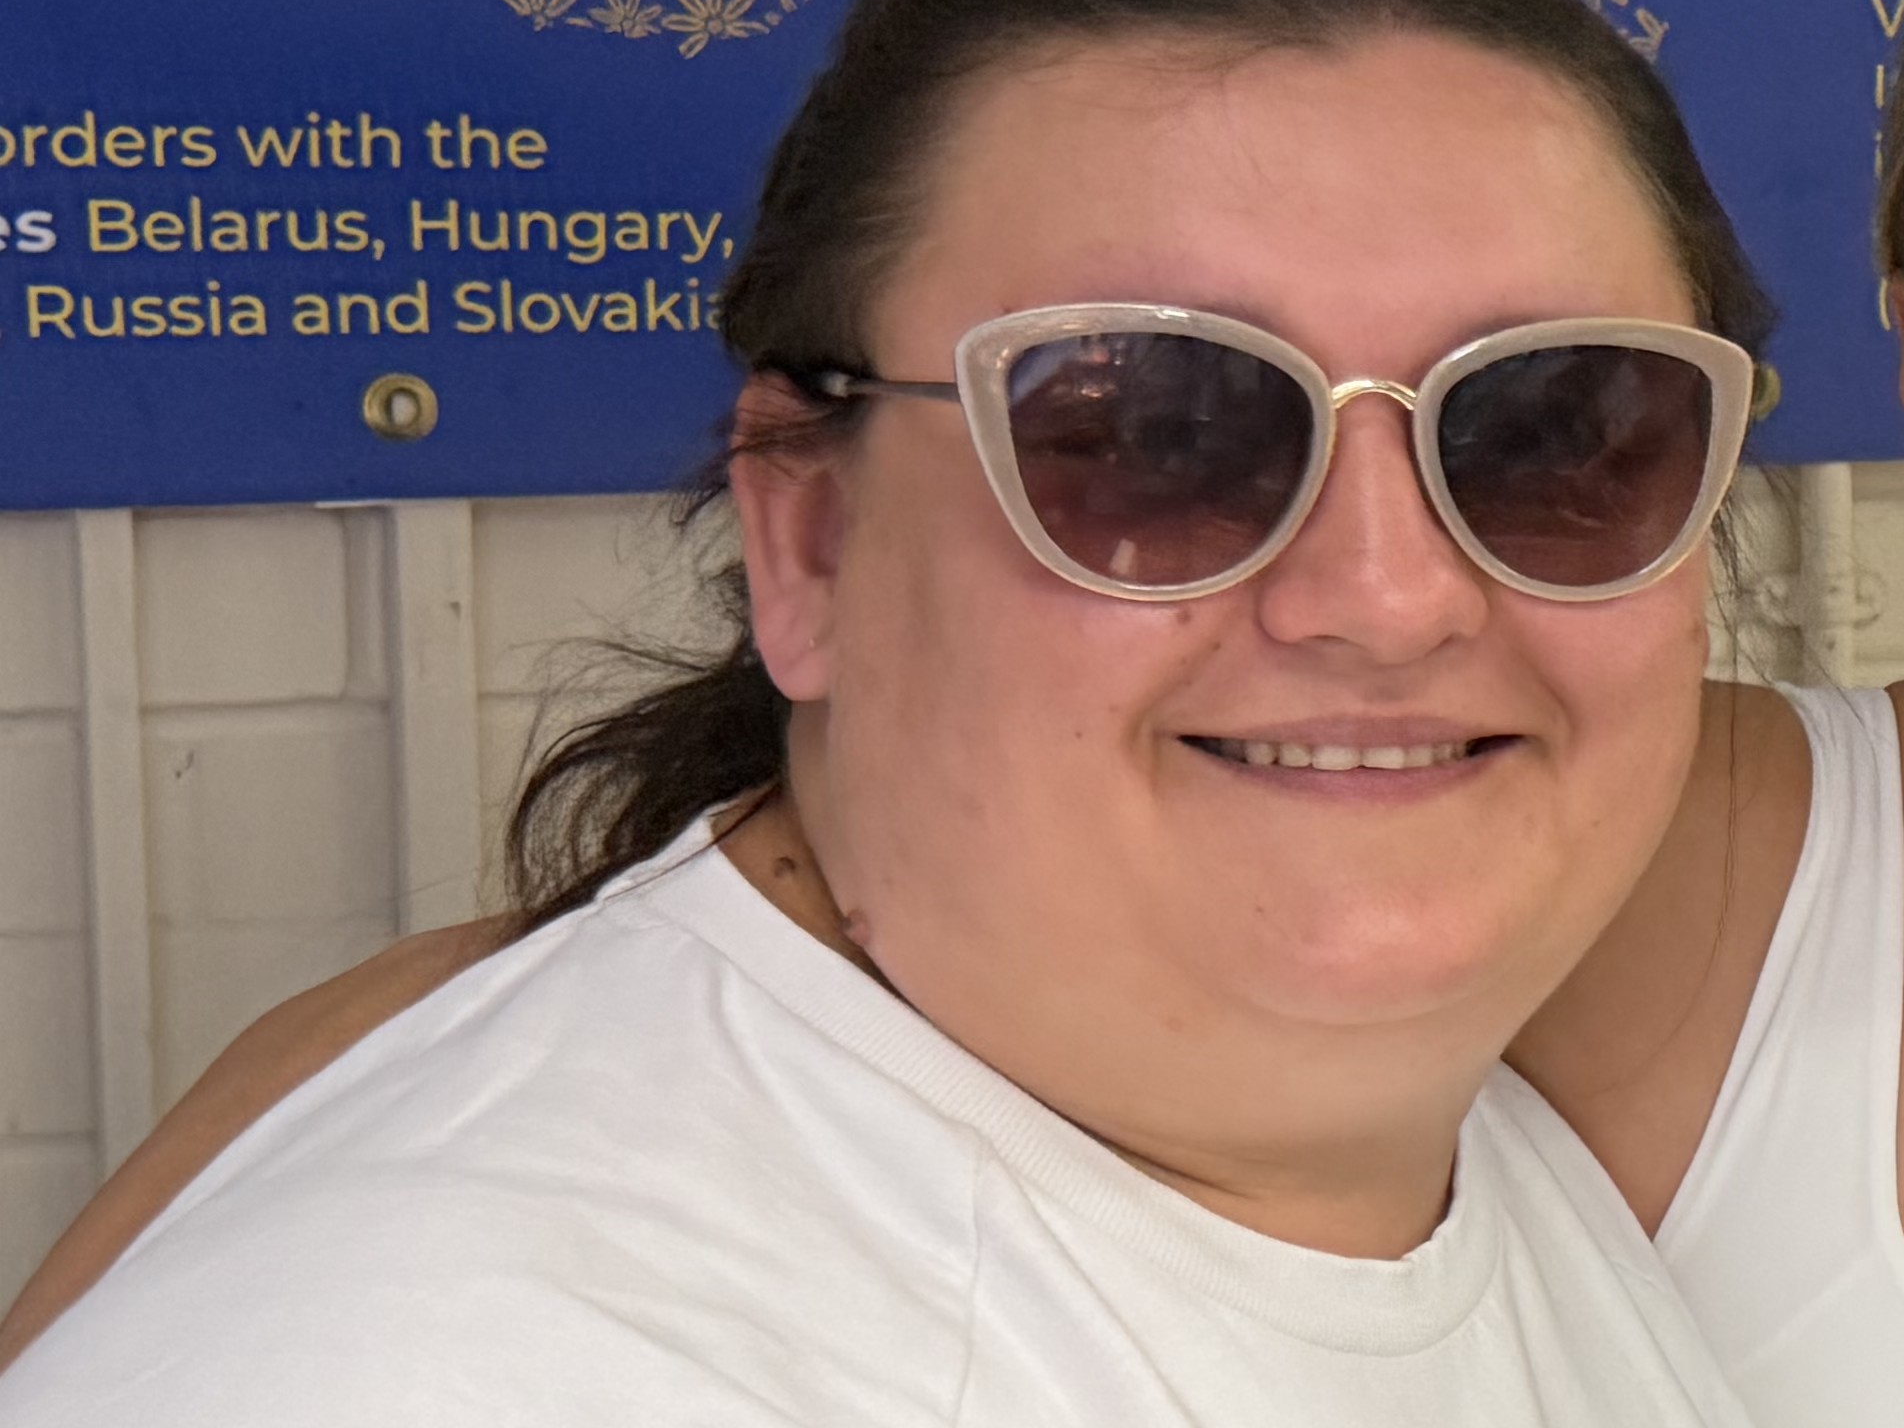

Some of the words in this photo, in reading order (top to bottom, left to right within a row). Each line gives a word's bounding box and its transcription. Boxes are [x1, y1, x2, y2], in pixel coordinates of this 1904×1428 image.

[236, 111, 402, 168] with
[425, 114, 548, 169] the
[87, 196, 386, 260] Belarus,
[410, 199, 735, 264] Hungary,
[26, 280, 268, 338] Russia
[291, 280, 429, 335] and
